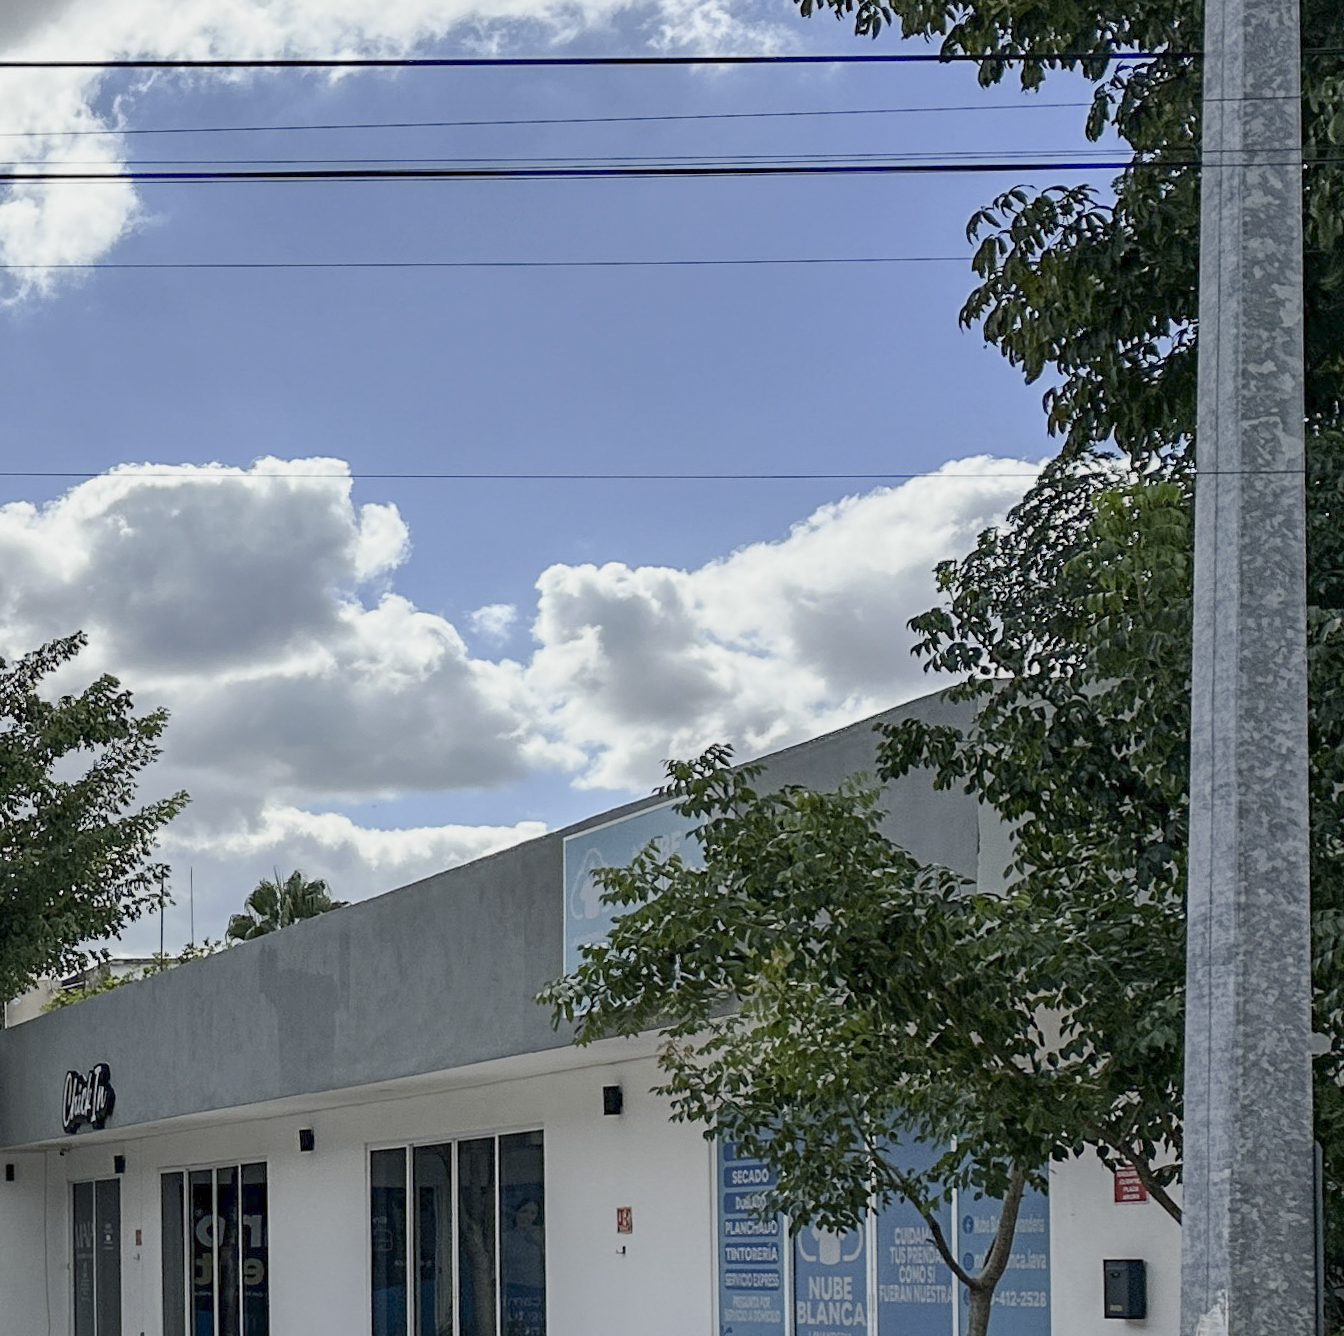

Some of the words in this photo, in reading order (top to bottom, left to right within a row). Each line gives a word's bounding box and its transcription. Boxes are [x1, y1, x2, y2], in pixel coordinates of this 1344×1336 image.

[732, 1170, 769, 1185] SECADO
[894, 1227, 934, 1245] CUIDAM
[725, 1242, 779, 1261] TINTORERÍA
[889, 1246, 906, 1264] TUS
[899, 1265, 926, 1283] COMO
[927, 1265, 936, 1284] SI
[808, 1276, 853, 1300] NUBE
[879, 1284, 912, 1303] FUERAN
[796, 1302, 868, 1326] BLANCA
